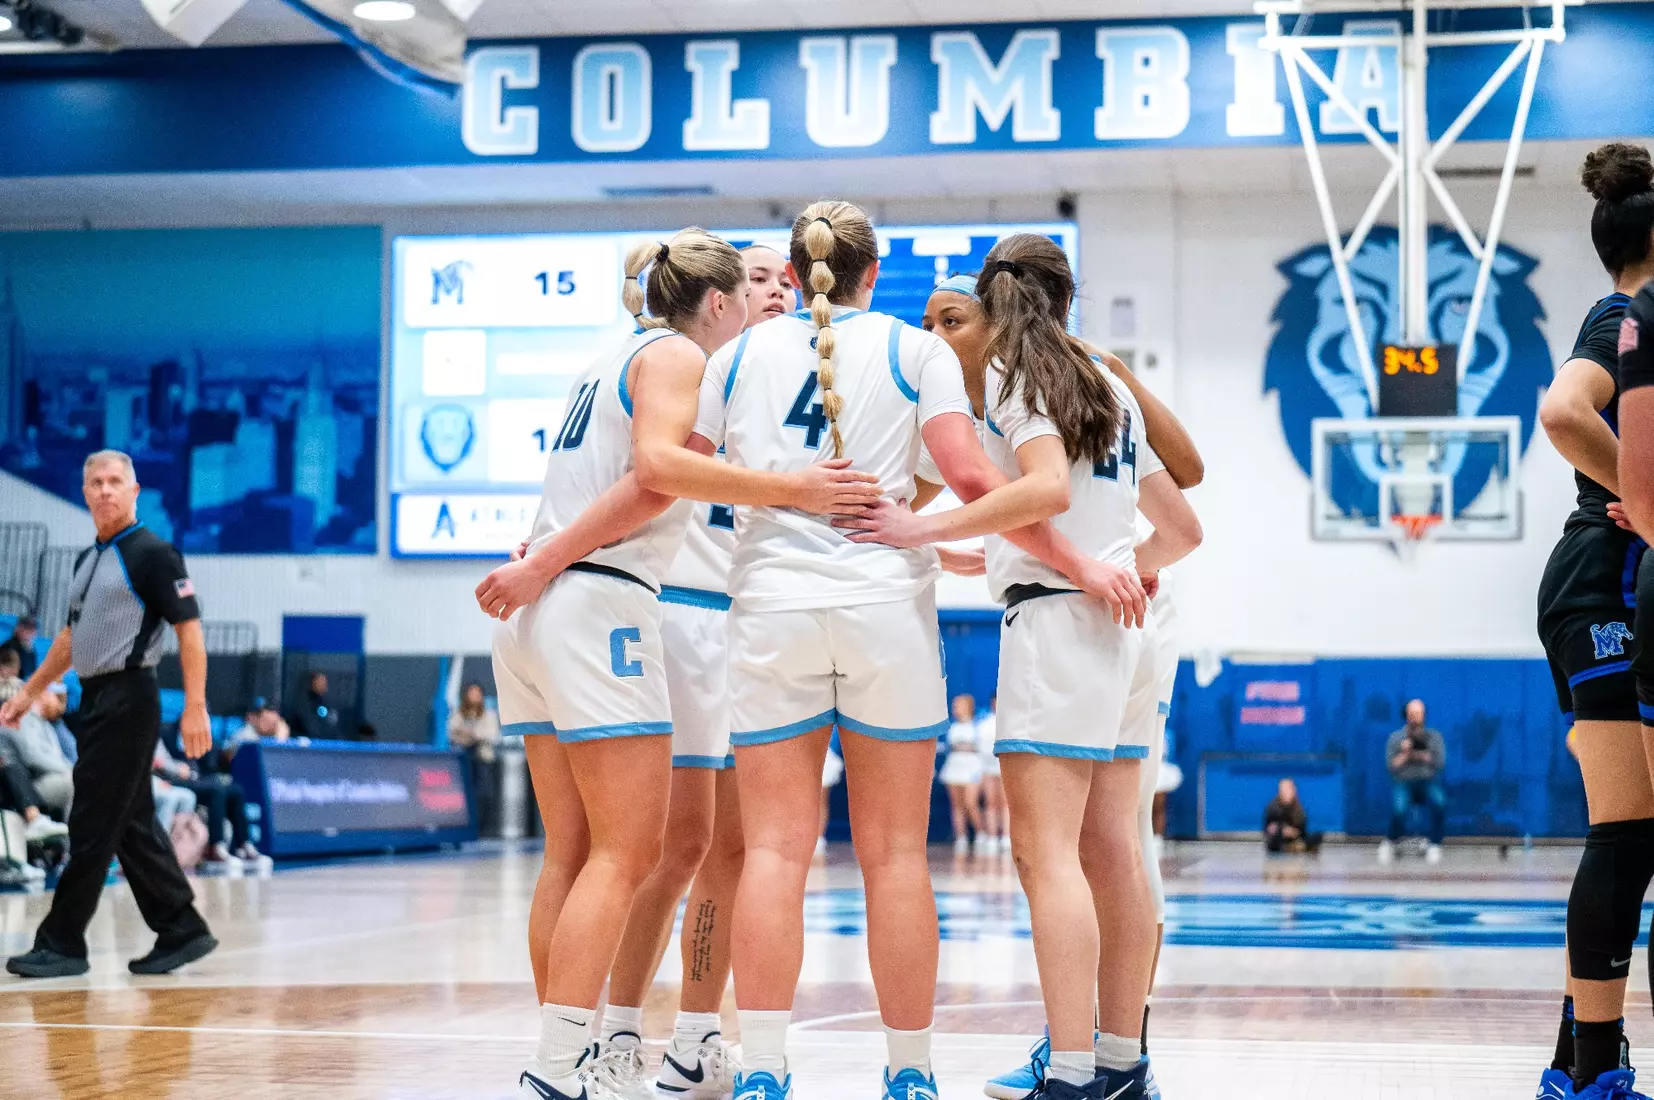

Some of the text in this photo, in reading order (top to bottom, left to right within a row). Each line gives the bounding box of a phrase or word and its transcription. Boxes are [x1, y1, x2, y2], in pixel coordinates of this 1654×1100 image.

[461, 19, 1403, 156] COLUMBIA
[534, 270, 576, 296] 15
[1384, 346, 1439, 375] 34.5
[551, 378, 601, 451] 10
[782, 369, 829, 450] 4
[608, 626, 644, 679] C
